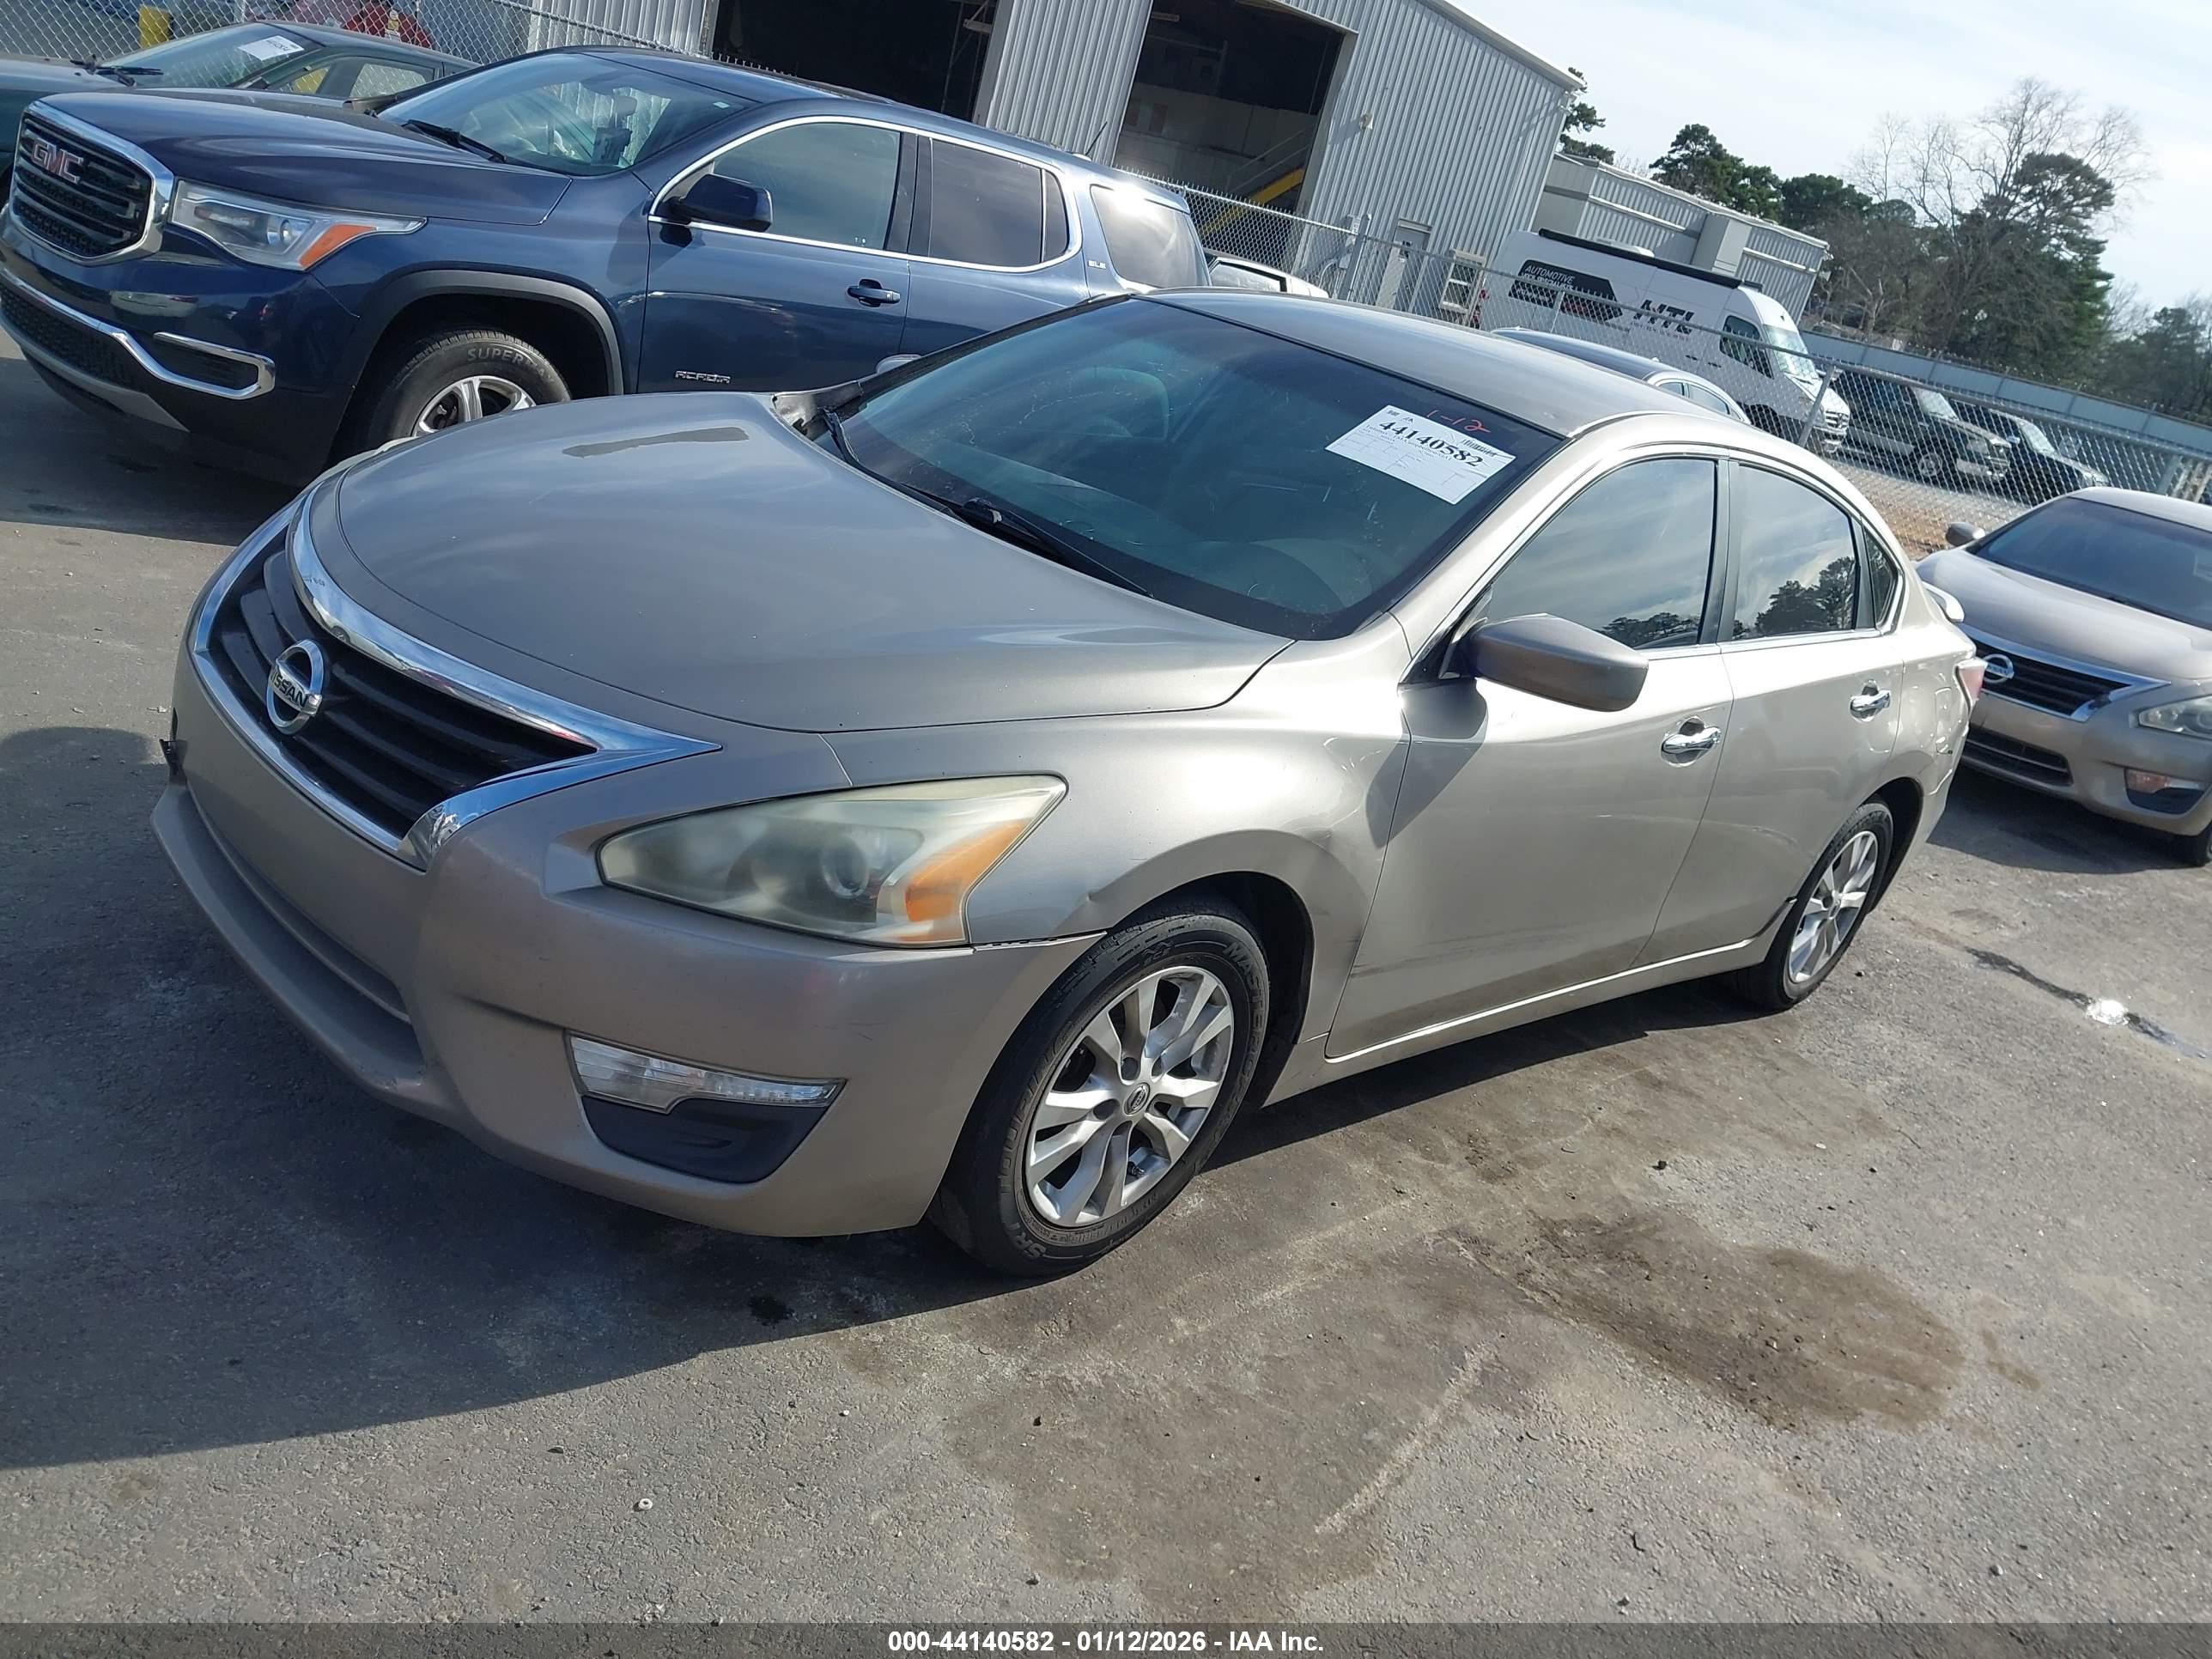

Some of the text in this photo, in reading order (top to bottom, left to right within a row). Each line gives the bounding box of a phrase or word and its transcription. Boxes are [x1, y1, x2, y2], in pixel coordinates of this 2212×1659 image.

[32, 137, 84, 185] GMC
[1524, 264, 1576, 285] AUTOMOTIVE
[675, 370, 731, 384] ACADIA
[1425, 410, 1492, 434] 1-12
[1378, 421, 1485, 468] 44140582
[270, 667, 309, 708] ISSAN
